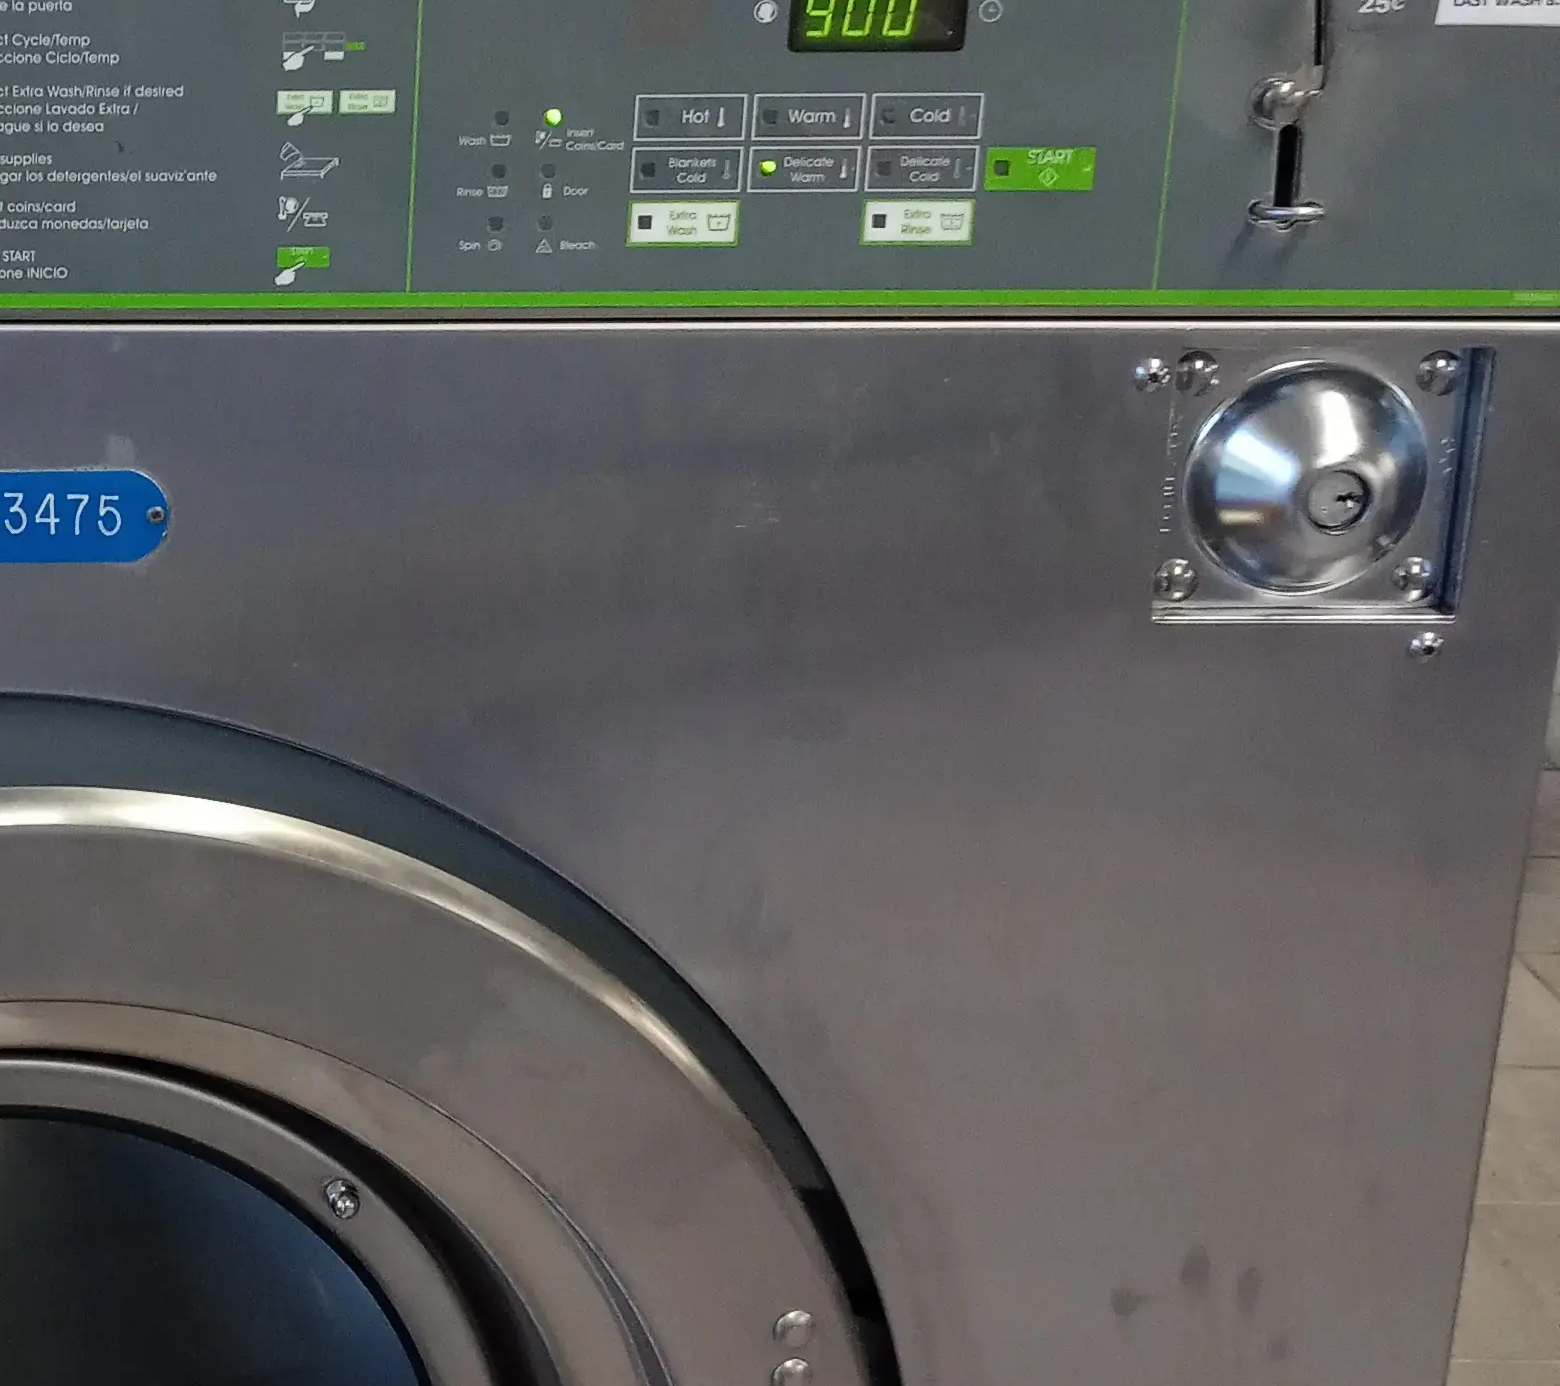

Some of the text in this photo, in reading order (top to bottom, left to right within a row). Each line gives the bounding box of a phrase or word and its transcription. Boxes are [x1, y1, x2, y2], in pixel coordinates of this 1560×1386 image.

[11, 0, 24, 12] la
[28, 0, 73, 14] puerta
[12, 33, 91, 49] Cycle/Temp
[45, 51, 120, 66] Ciclo/Temp
[12, 85, 44, 98] Extra
[47, 85, 120, 99] Wash/Rinse
[123, 85, 132, 98] if
[135, 85, 184, 98] desired
[46, 102, 95, 115] Lavado
[99, 102, 130, 115] Extra
[682, 108, 951, 124] Hot Warm Cold
[34, 119, 44, 132] si
[47, 120, 59, 132] lo
[62, 119, 104, 132] desea
[566, 128, 594, 138] Insert
[459, 135, 487, 146] Wash
[565, 141, 625, 151] Coins/Card
[0, 153, 53, 168] supplies
[668, 157, 717, 168] Blankets
[783, 156, 834, 168] Delicate
[900, 156, 951, 168] Delicate
[1026, 149, 1075, 165] START
[25, 169, 44, 182] los
[47, 169, 142, 184] detergentes/el
[676, 172, 707, 184] Cold
[790, 172, 825, 183] Warm
[909, 171, 940, 183] Cold
[456, 187, 484, 197] Rinse
[563, 187, 589, 196] Door
[7, 201, 76, 213] coins/card
[669, 210, 697, 220] Extra
[904, 209, 932, 219] Extra
[41, 217, 149, 233] monedas/tarjeta
[667, 225, 698, 236] Wash
[900, 224, 932, 235] Rinse
[459, 240, 481, 250] Spin
[559, 240, 596, 250] Bleach
[2, 250, 36, 262] START
[27, 266, 69, 279] INICIO
